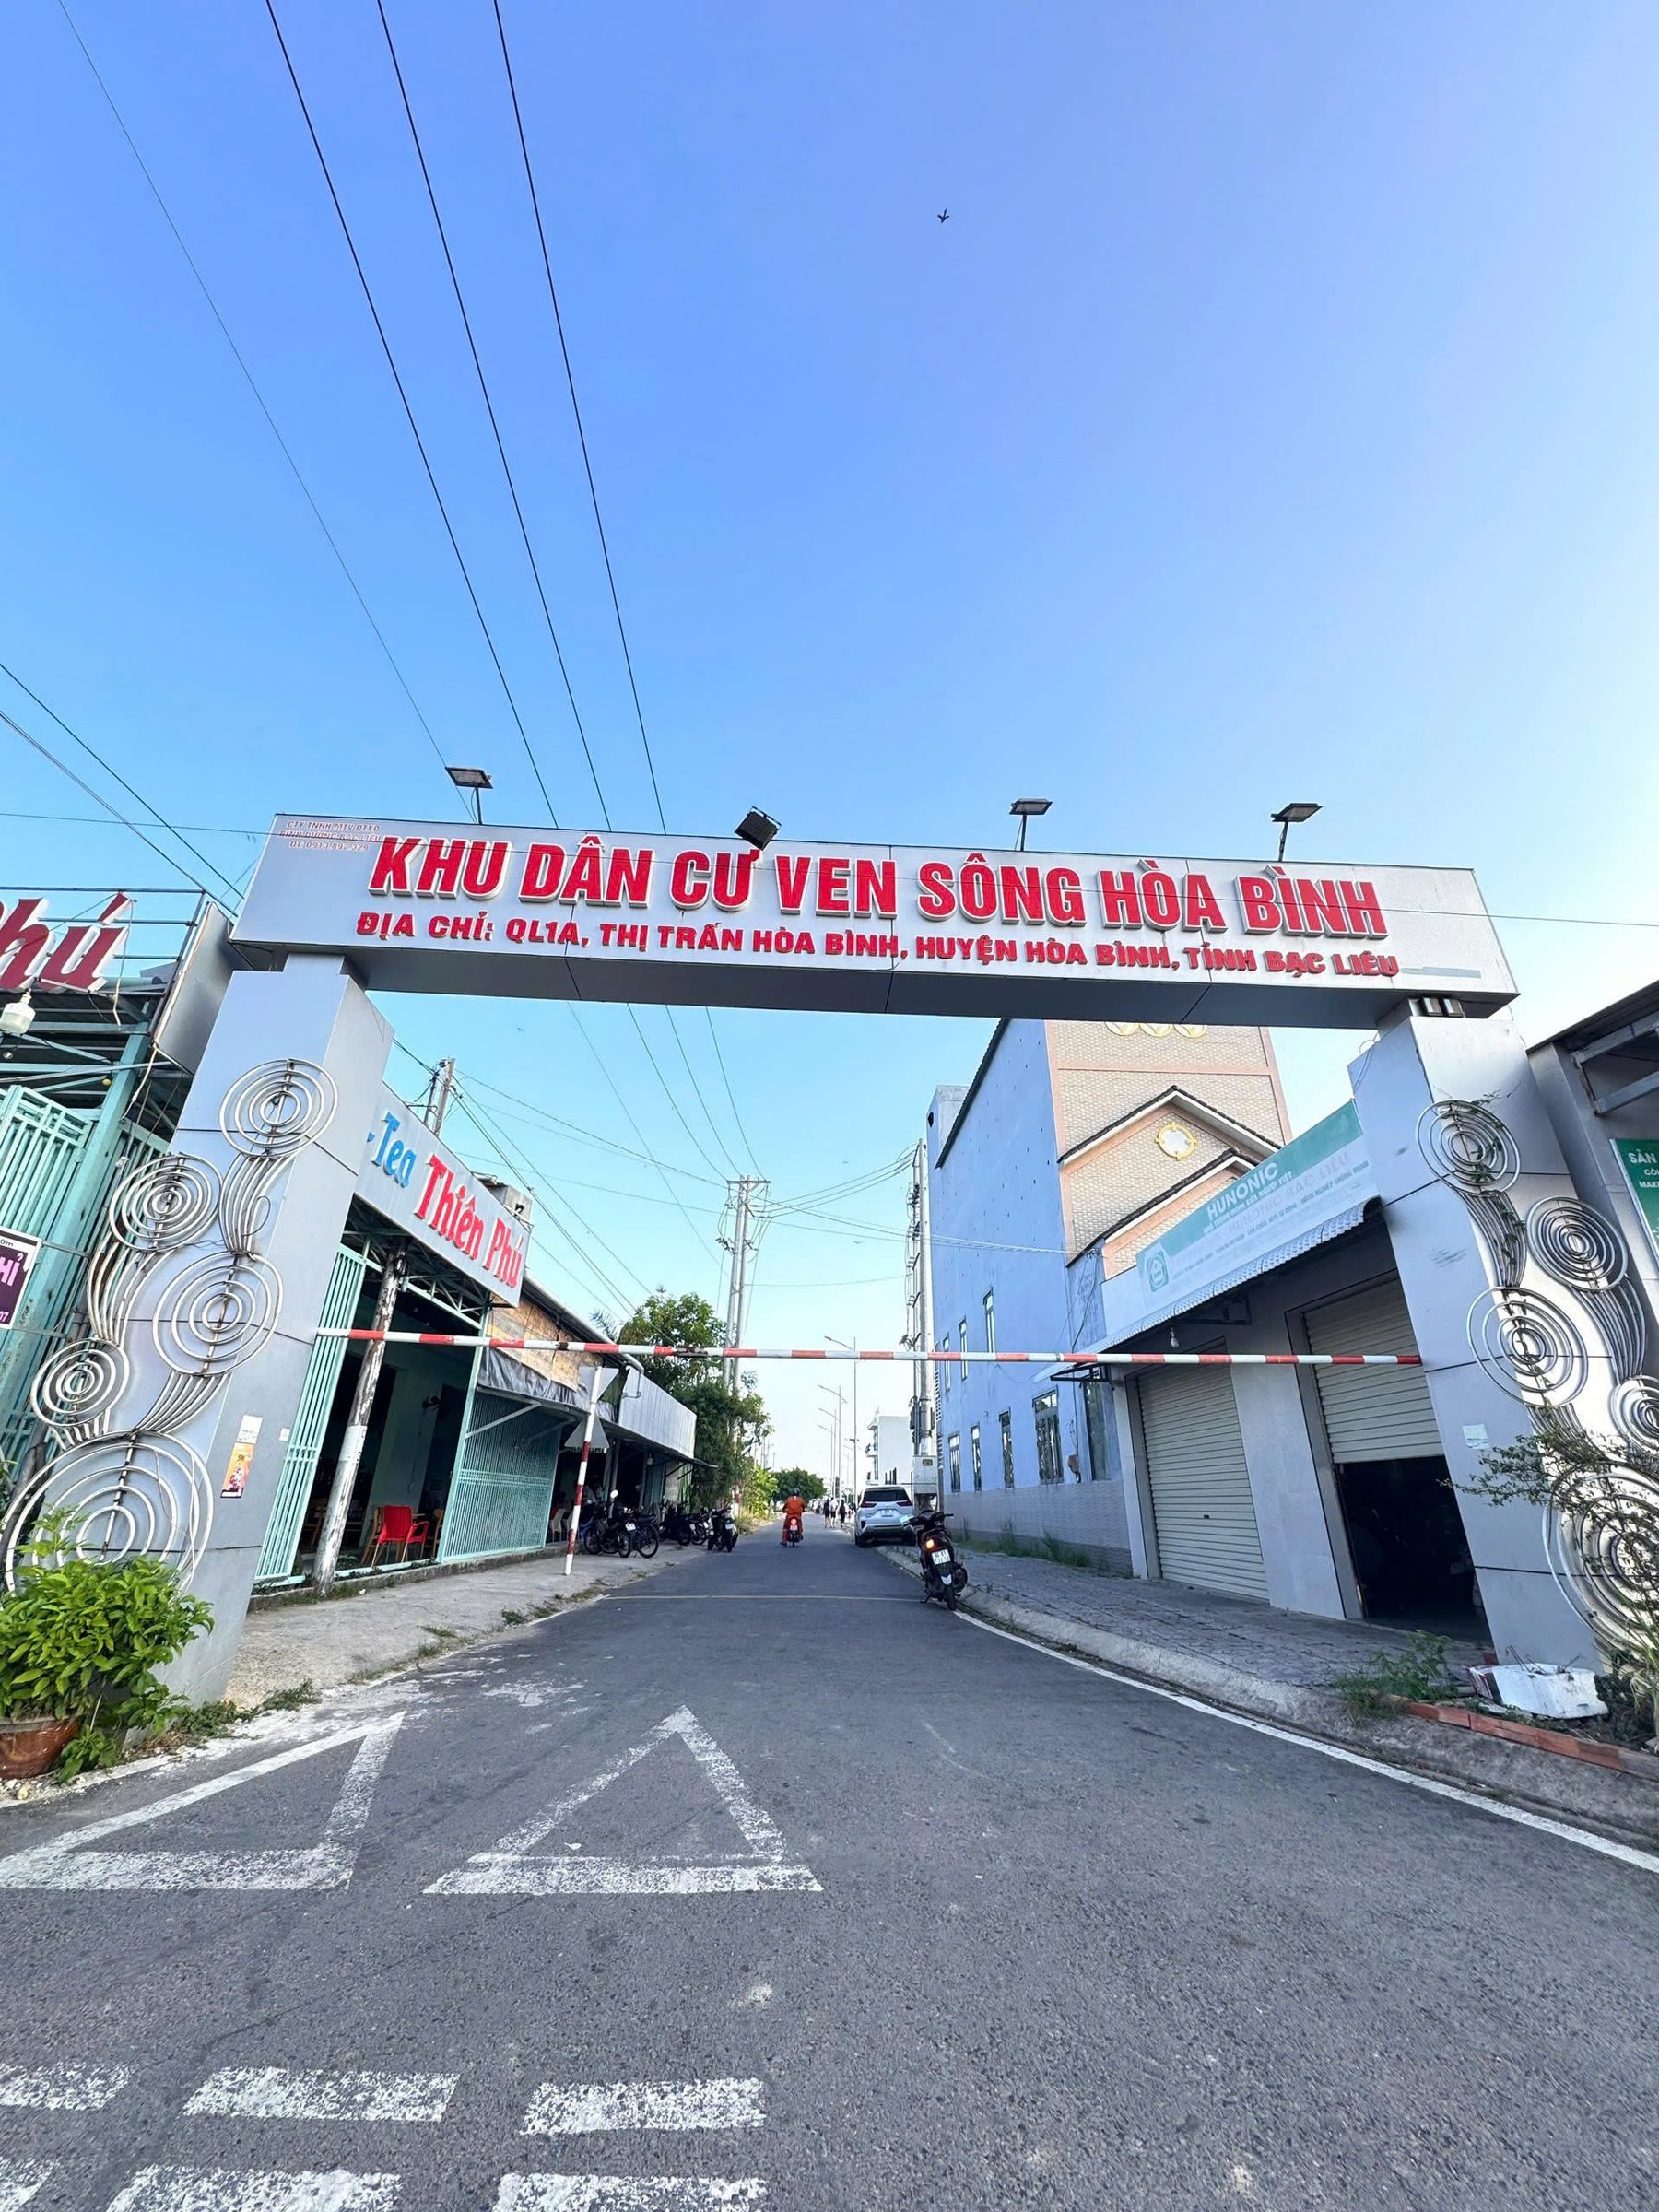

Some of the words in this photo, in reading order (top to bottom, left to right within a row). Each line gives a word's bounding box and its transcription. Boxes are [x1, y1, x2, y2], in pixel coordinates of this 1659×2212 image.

[368, 836, 512, 900] KHU
[518, 832, 656, 909] DÂN
[670, 847, 764, 912] CƯ
[774, 854, 898, 920] VEN
[916, 851, 1087, 927] SÔNG
[1097, 858, 1229, 934] HÒA
[1234, 865, 1389, 940] BÌNH
[0, 890, 130, 993] hú
[356, 912, 416, 940] ĐỊA
[428, 910, 494, 941] CHỈ:
[505, 918, 590, 947] QL1A,
[599, 924, 649, 952] THỊ
[657, 922, 744, 951] TRẤN
[752, 926, 816, 955] HÒA
[825, 929, 908, 960] BÌNH,
[915, 934, 1018, 965] HUYỆN
[1024, 937, 1088, 965] HÒA
[1094, 940, 1181, 971] BÌNH,
[1182, 941, 1258, 971] TỈNH
[1263, 950, 1327, 978] BẠC
[1332, 950, 1401, 977] LIÊU
[414, 1154, 485, 1261] Thiên
[482, 1217, 523, 1288] Phú
[1206, 1161, 1279, 1221] HUNONIC
